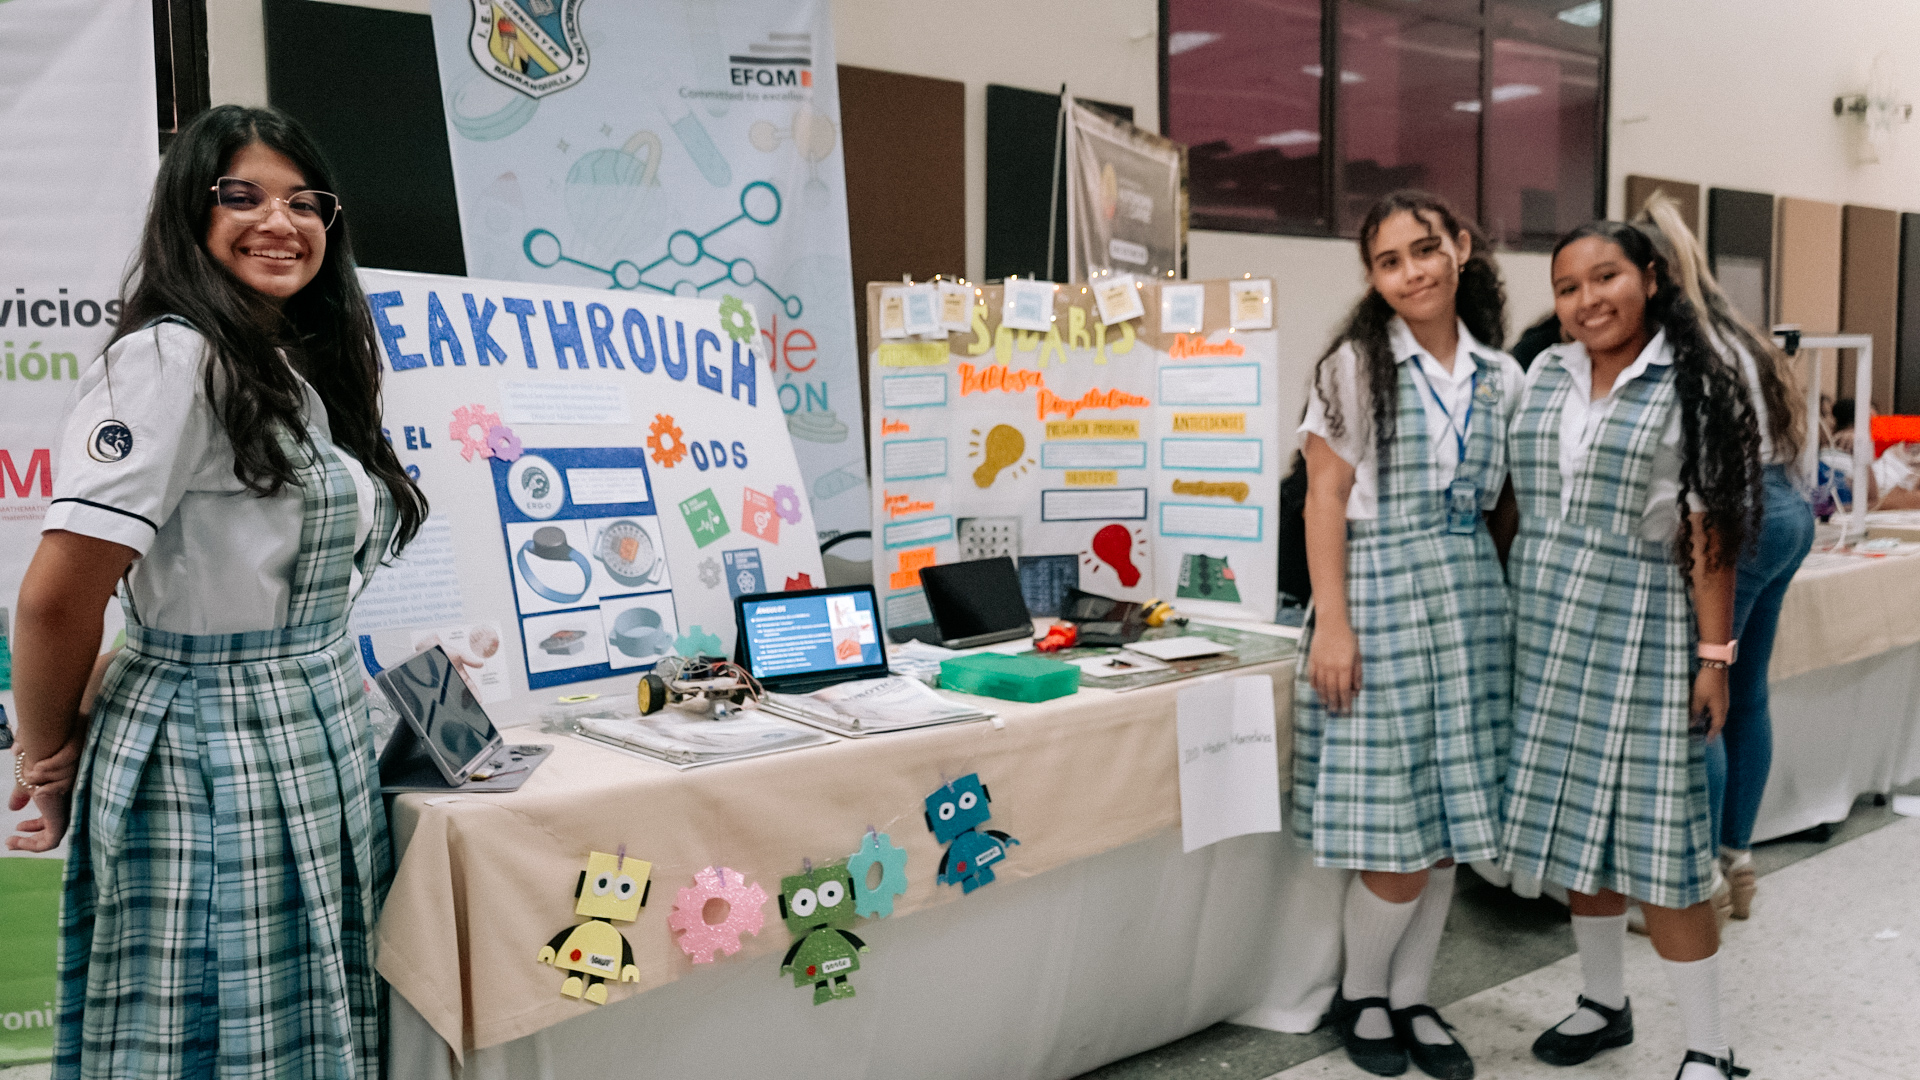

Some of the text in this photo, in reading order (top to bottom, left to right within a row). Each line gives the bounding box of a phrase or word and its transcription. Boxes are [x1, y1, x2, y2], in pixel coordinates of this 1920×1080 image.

[494, 65, 572, 91] BARRANQUILLA
[731, 67, 797, 87] EFQM
[0, 341, 79, 381] ión
[403, 426, 432, 450] EL
[691, 440, 748, 472] ODS
[0, 1001, 53, 1030] oni
